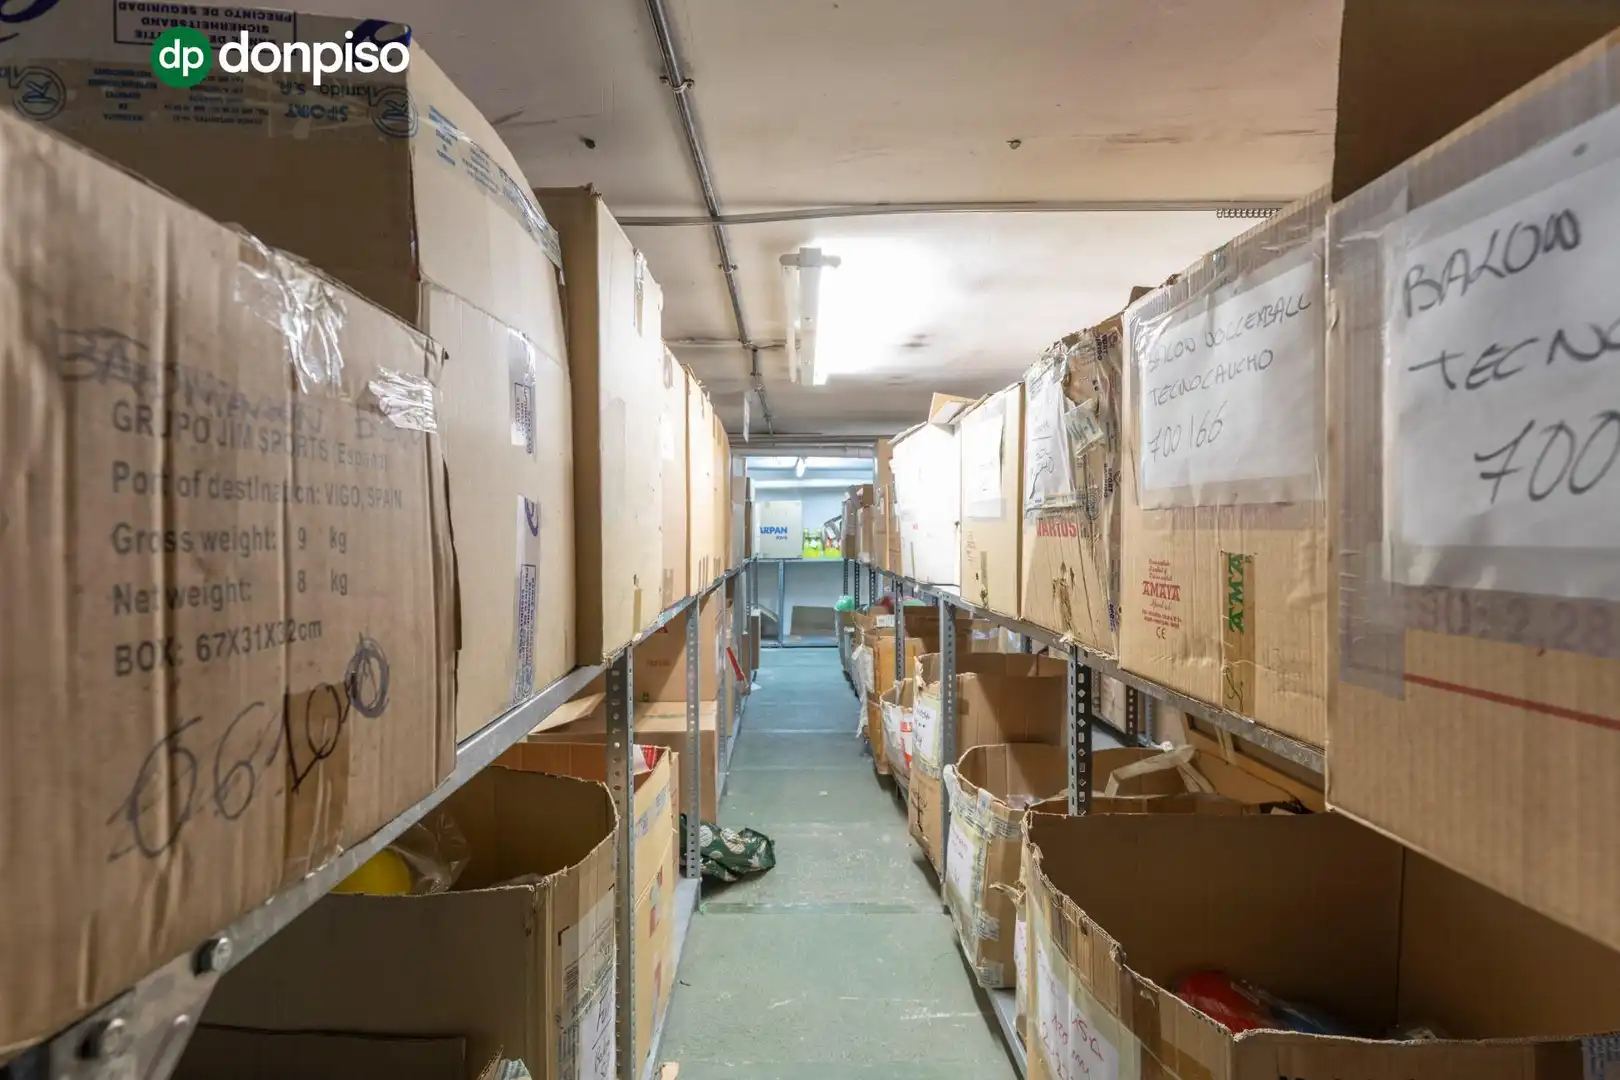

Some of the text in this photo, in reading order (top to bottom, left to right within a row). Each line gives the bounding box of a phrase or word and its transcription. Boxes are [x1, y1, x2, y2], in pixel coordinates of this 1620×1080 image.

[176, 469, 203, 499] of
[367, 486, 403, 510] SPAIN
[112, 522, 347, 558] Gross weight: 9 kg
[330, 569, 348, 596] kg
[1142, 580, 1181, 602] AMAYA
